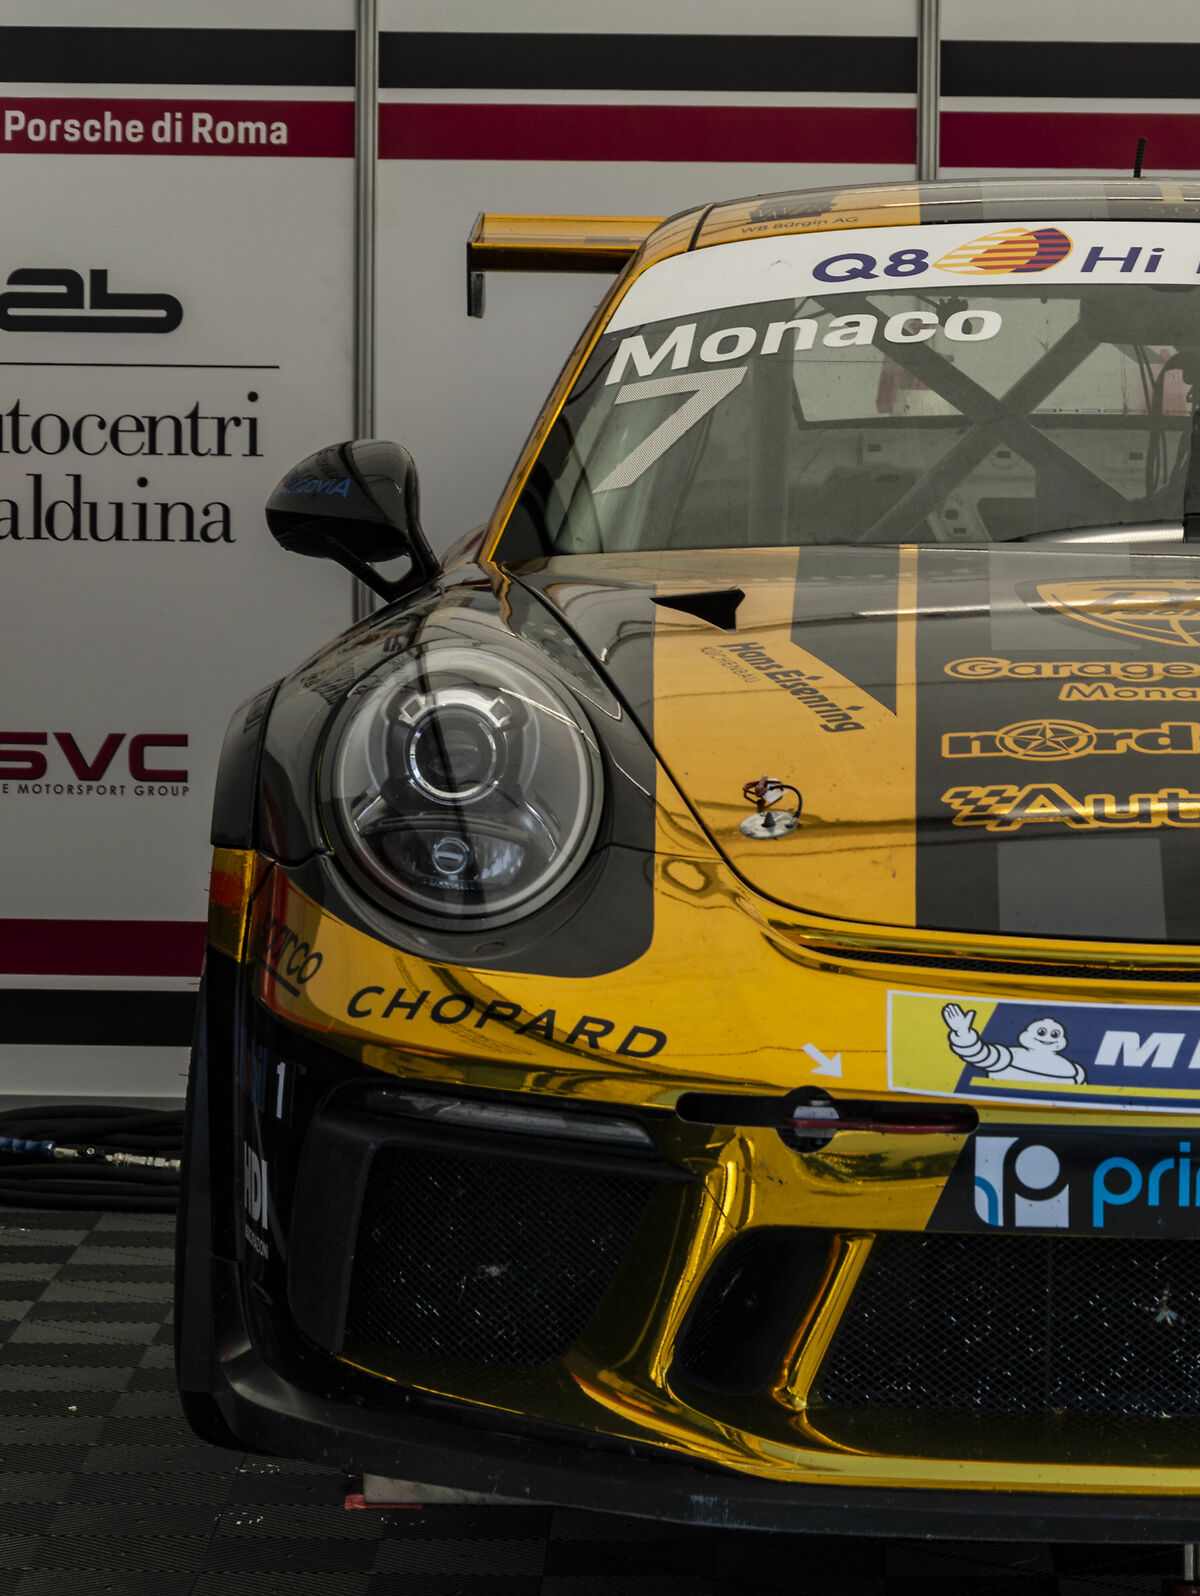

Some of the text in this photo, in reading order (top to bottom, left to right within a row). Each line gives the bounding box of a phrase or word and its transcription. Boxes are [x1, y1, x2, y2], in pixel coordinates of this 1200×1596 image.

[3, 110, 289, 145] Porsche di Roma
[811, 248, 929, 283] Q8
[1080, 246, 1162, 274] Hi
[604, 309, 1003, 385] Monaco
[0, 391, 265, 457] tocentri
[591, 366, 748, 494] 7
[716, 641, 784, 672] Hans
[763, 668, 866, 733] Eisenring
[0, 732, 189, 783] SVC
[17, 783, 126, 796] MOTORSPORT
[134, 785, 190, 797] GROUP
[346, 985, 668, 1058] CHOPARD
[276, 1061, 286, 1120] 1
[243, 1140, 268, 1231] HDI
